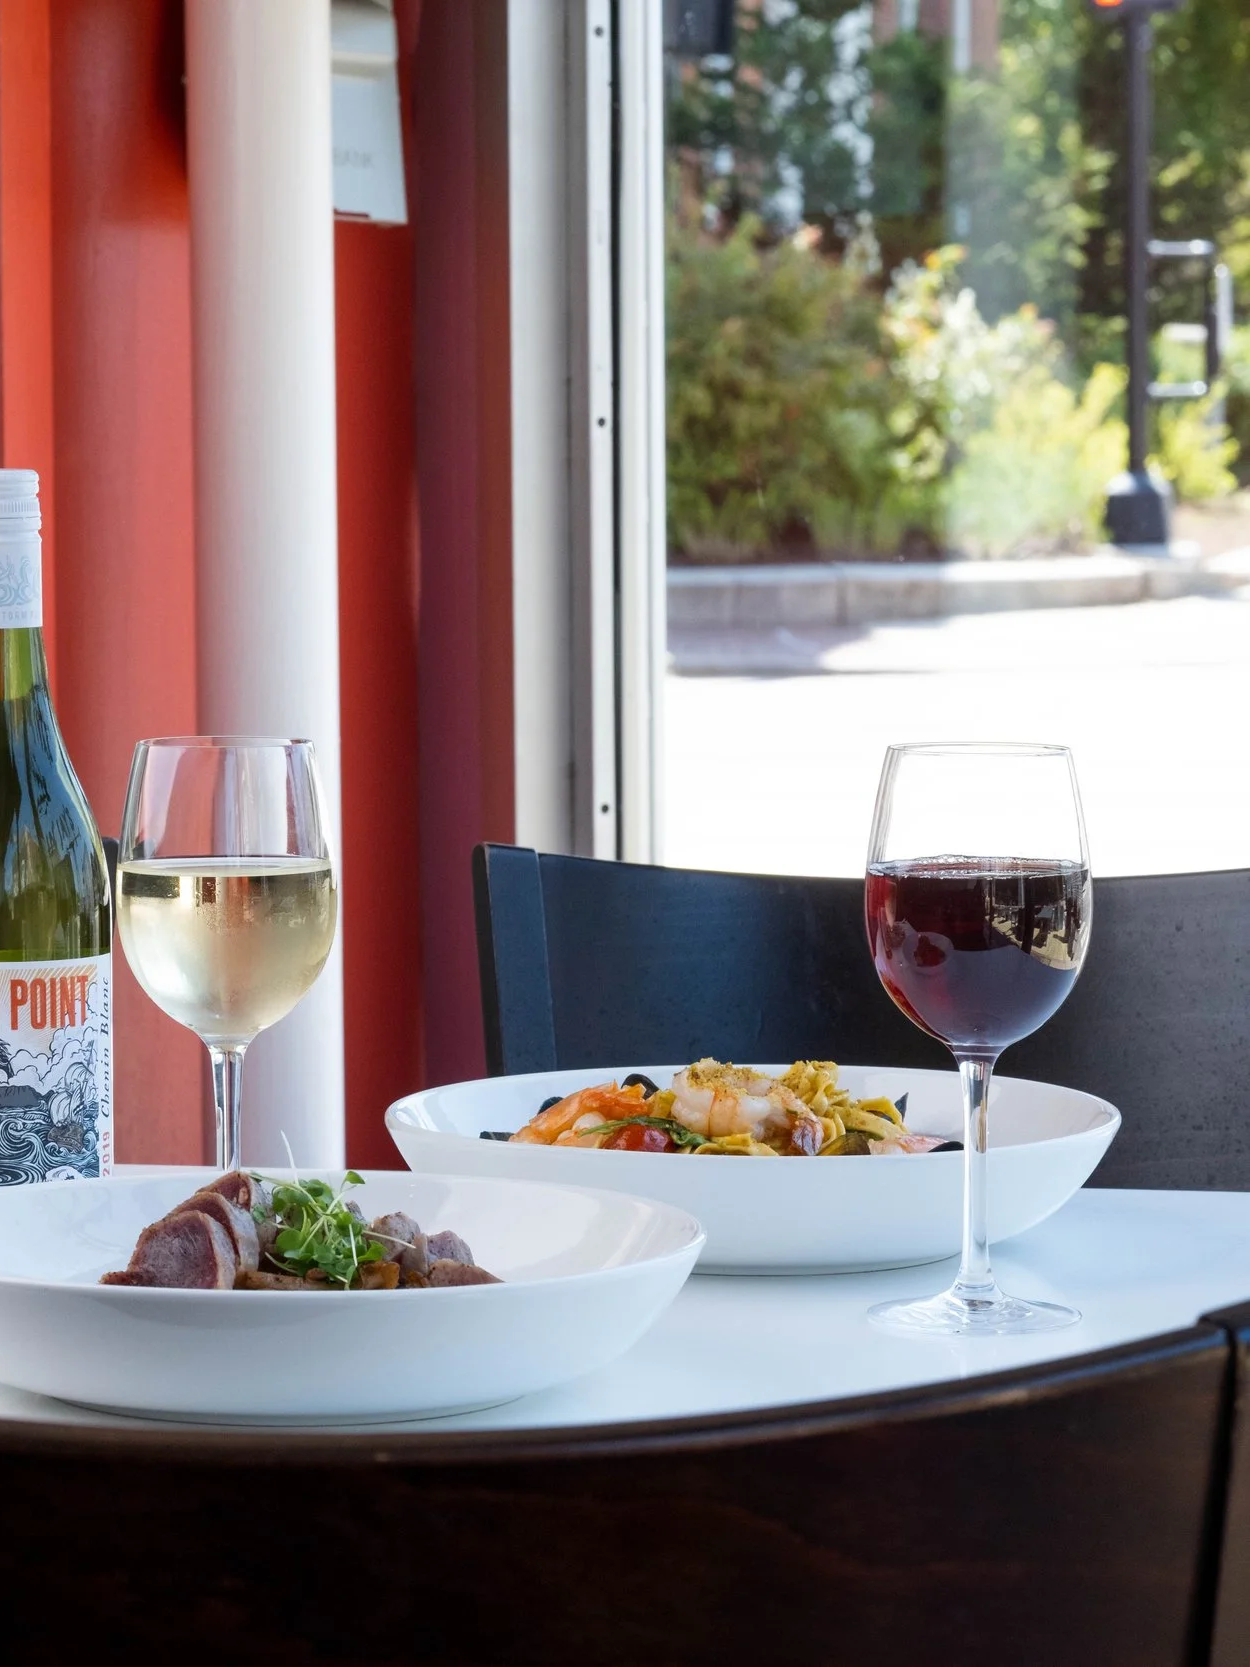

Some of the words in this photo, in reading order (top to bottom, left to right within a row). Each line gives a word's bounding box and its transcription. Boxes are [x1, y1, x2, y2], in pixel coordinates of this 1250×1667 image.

[10, 975, 89, 1031] POINT
[100, 977, 110, 1036] Blanc
[100, 1047, 111, 1118] Chenin
[102, 1131, 111, 1177] 2019
